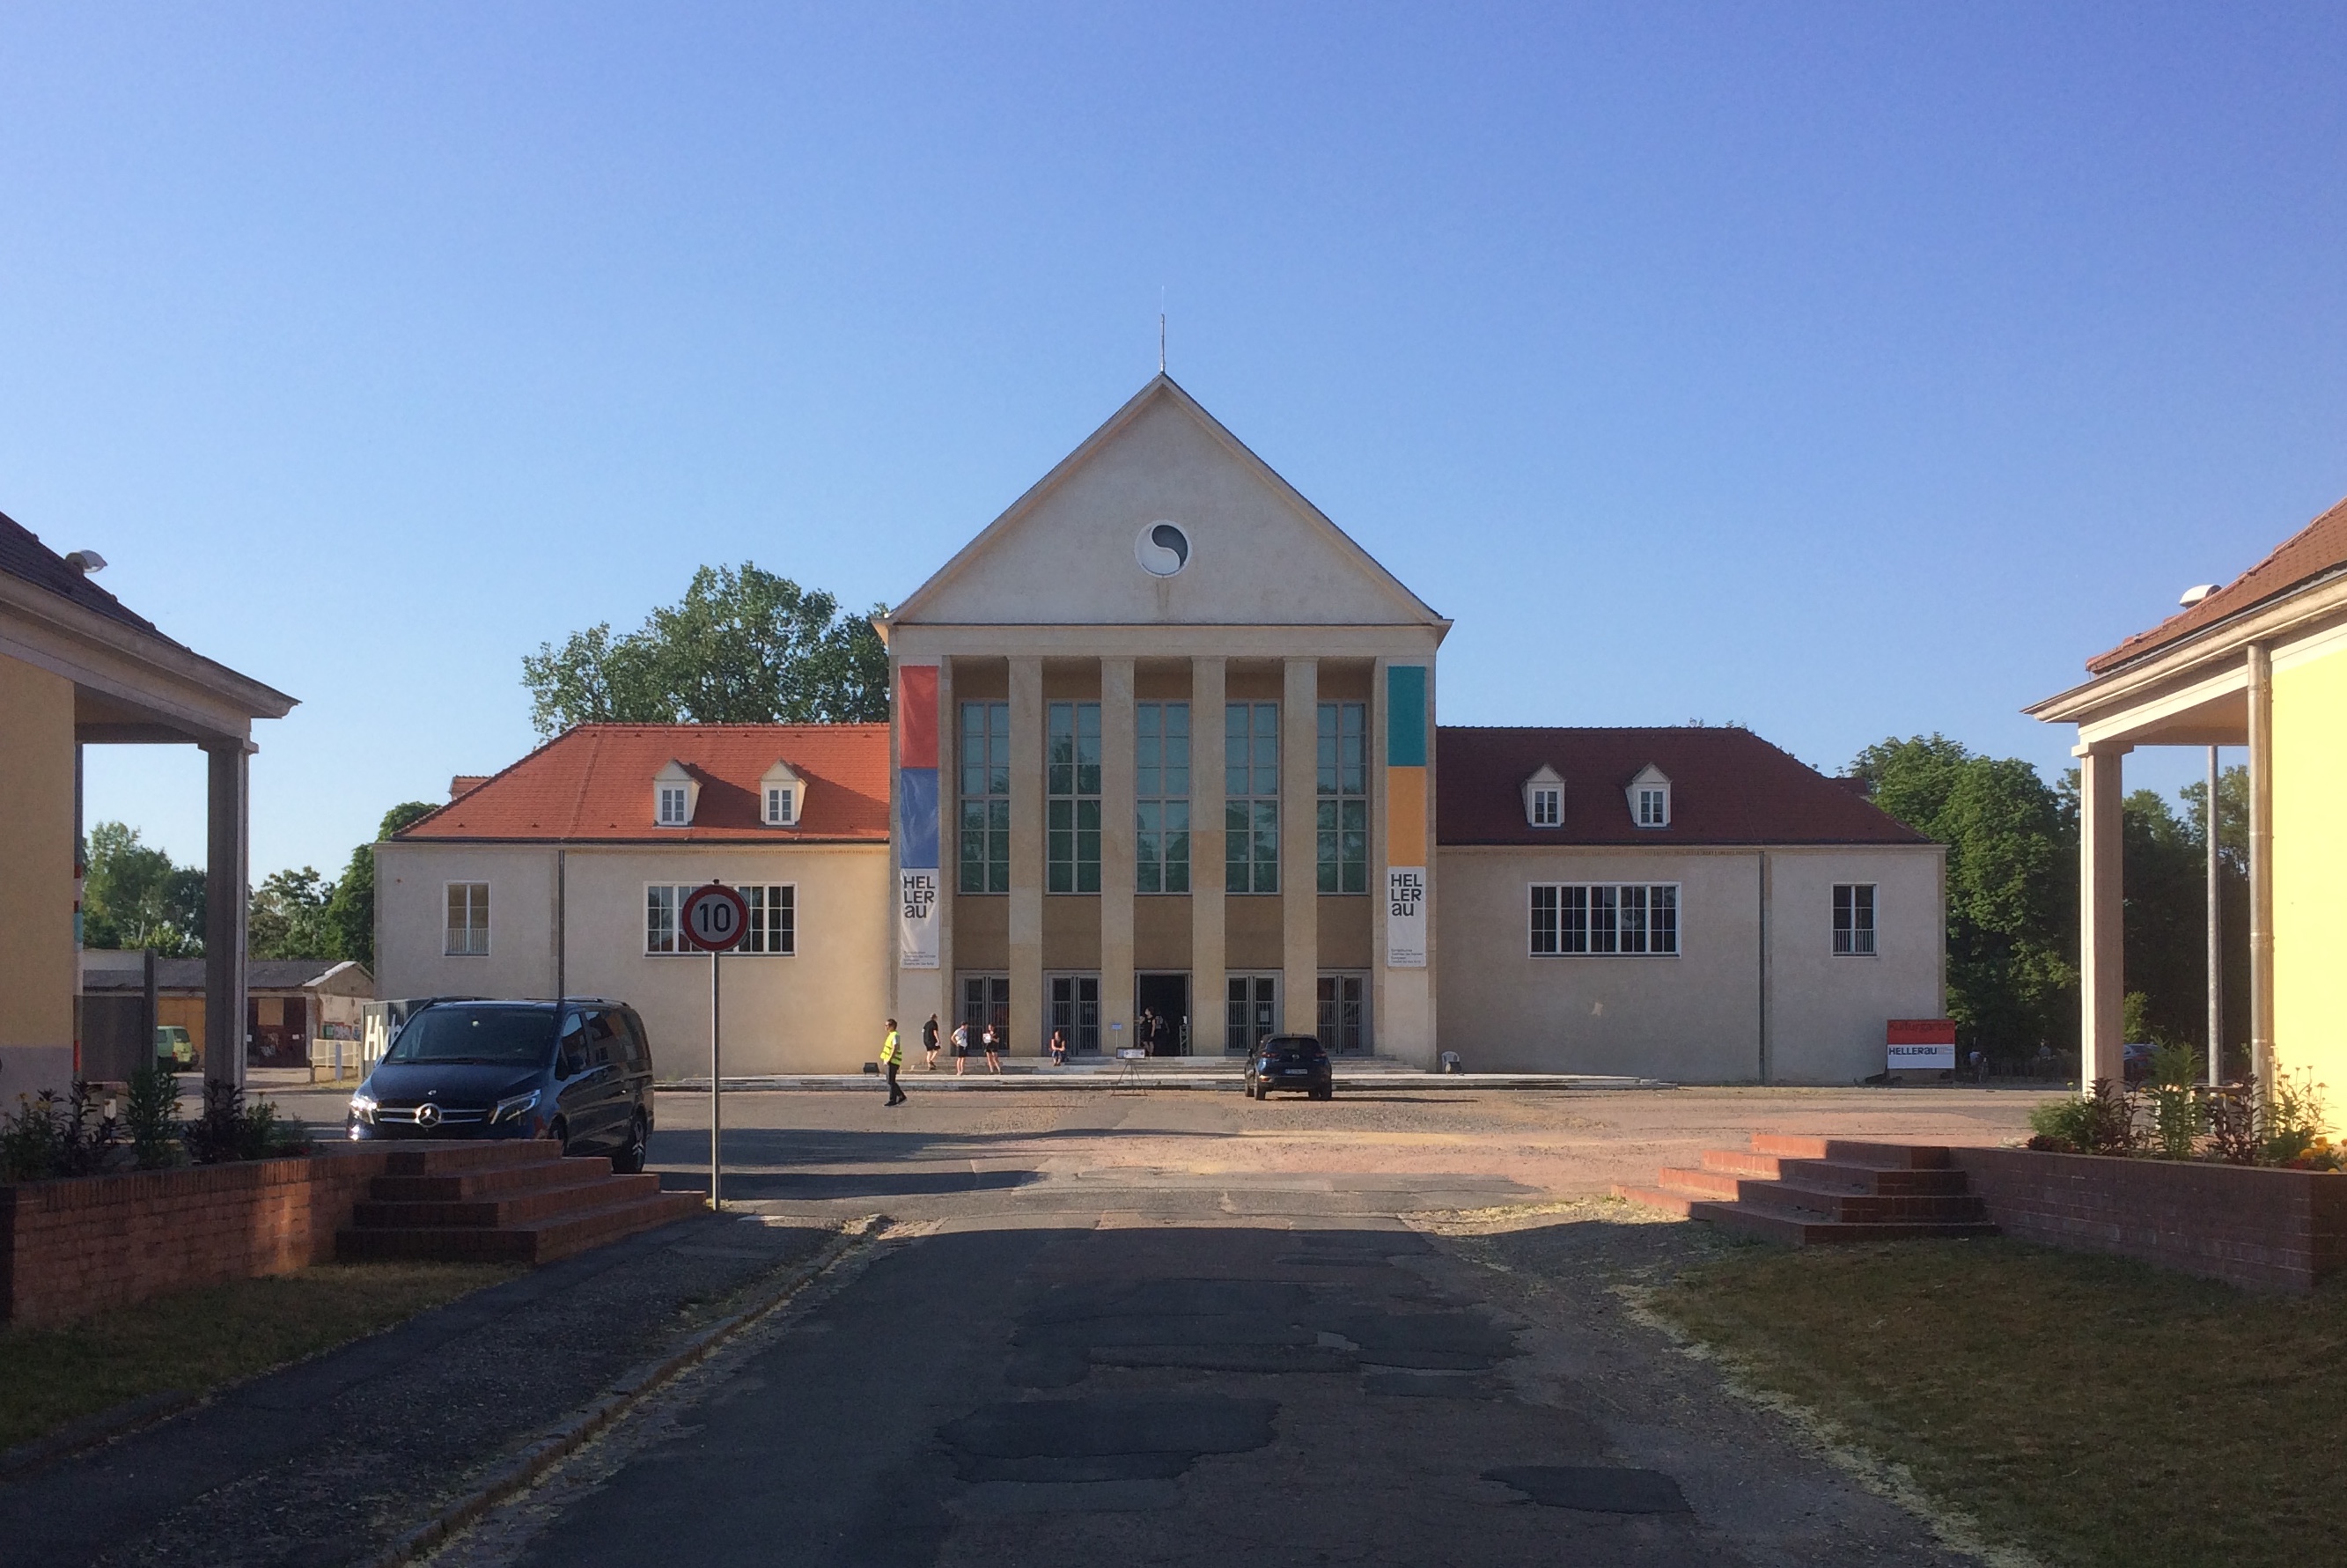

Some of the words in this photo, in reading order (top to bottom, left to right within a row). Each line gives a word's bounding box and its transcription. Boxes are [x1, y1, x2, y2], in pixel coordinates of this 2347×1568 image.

[903, 876, 935, 889] HEL
[1391, 874, 1423, 887] HEL
[904, 891, 935, 904] LER
[1391, 888, 1422, 902] LER
[904, 905, 927, 919] au
[1391, 902, 1414, 917] au
[699, 903, 731, 932] 10
[1888, 1047, 1938, 1056] HELLERau
